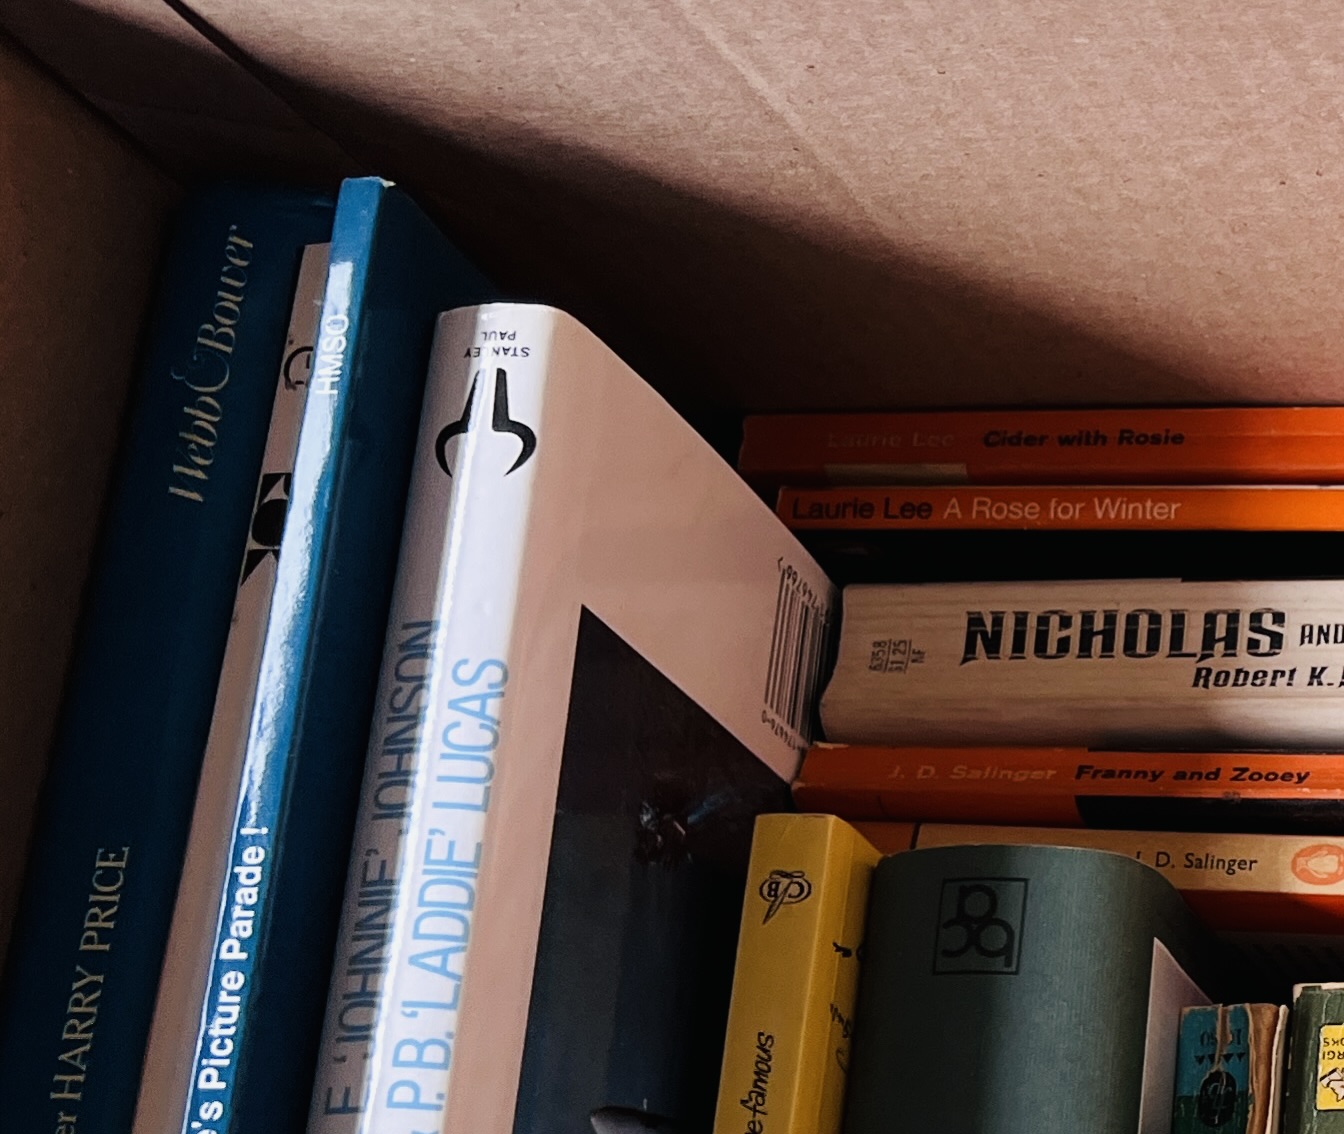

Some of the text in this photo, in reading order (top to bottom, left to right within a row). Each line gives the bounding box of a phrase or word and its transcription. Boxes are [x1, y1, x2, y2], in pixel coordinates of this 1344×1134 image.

[482, 330, 517, 342] PAUL
[168, 224, 256, 502] Webb Bower
[315, 313, 349, 395] HMSO
[464, 346, 531, 359] STANLEY
[982, 429, 1050, 448] Cider
[1057, 428, 1109, 447] with
[1117, 427, 1186, 446] Rosie
[791, 496, 1183, 521] Laurie Lee A Rose for Winter
[959, 607, 1287, 667] NICHOLAS
[1191, 666, 1298, 689] Robert
[432, 657, 510, 812] LUCAS
[949, 764, 1058, 785] Salinger
[1073, 764, 1165, 786] Franny
[1172, 765, 1222, 783] and
[1229, 766, 1310, 788] Zooey
[1183, 852, 1258, 874] Salinger
[50, 965, 103, 1101] HARRY
[80, 846, 130, 952] PRICE
[199, 969, 246, 1090] Picture
